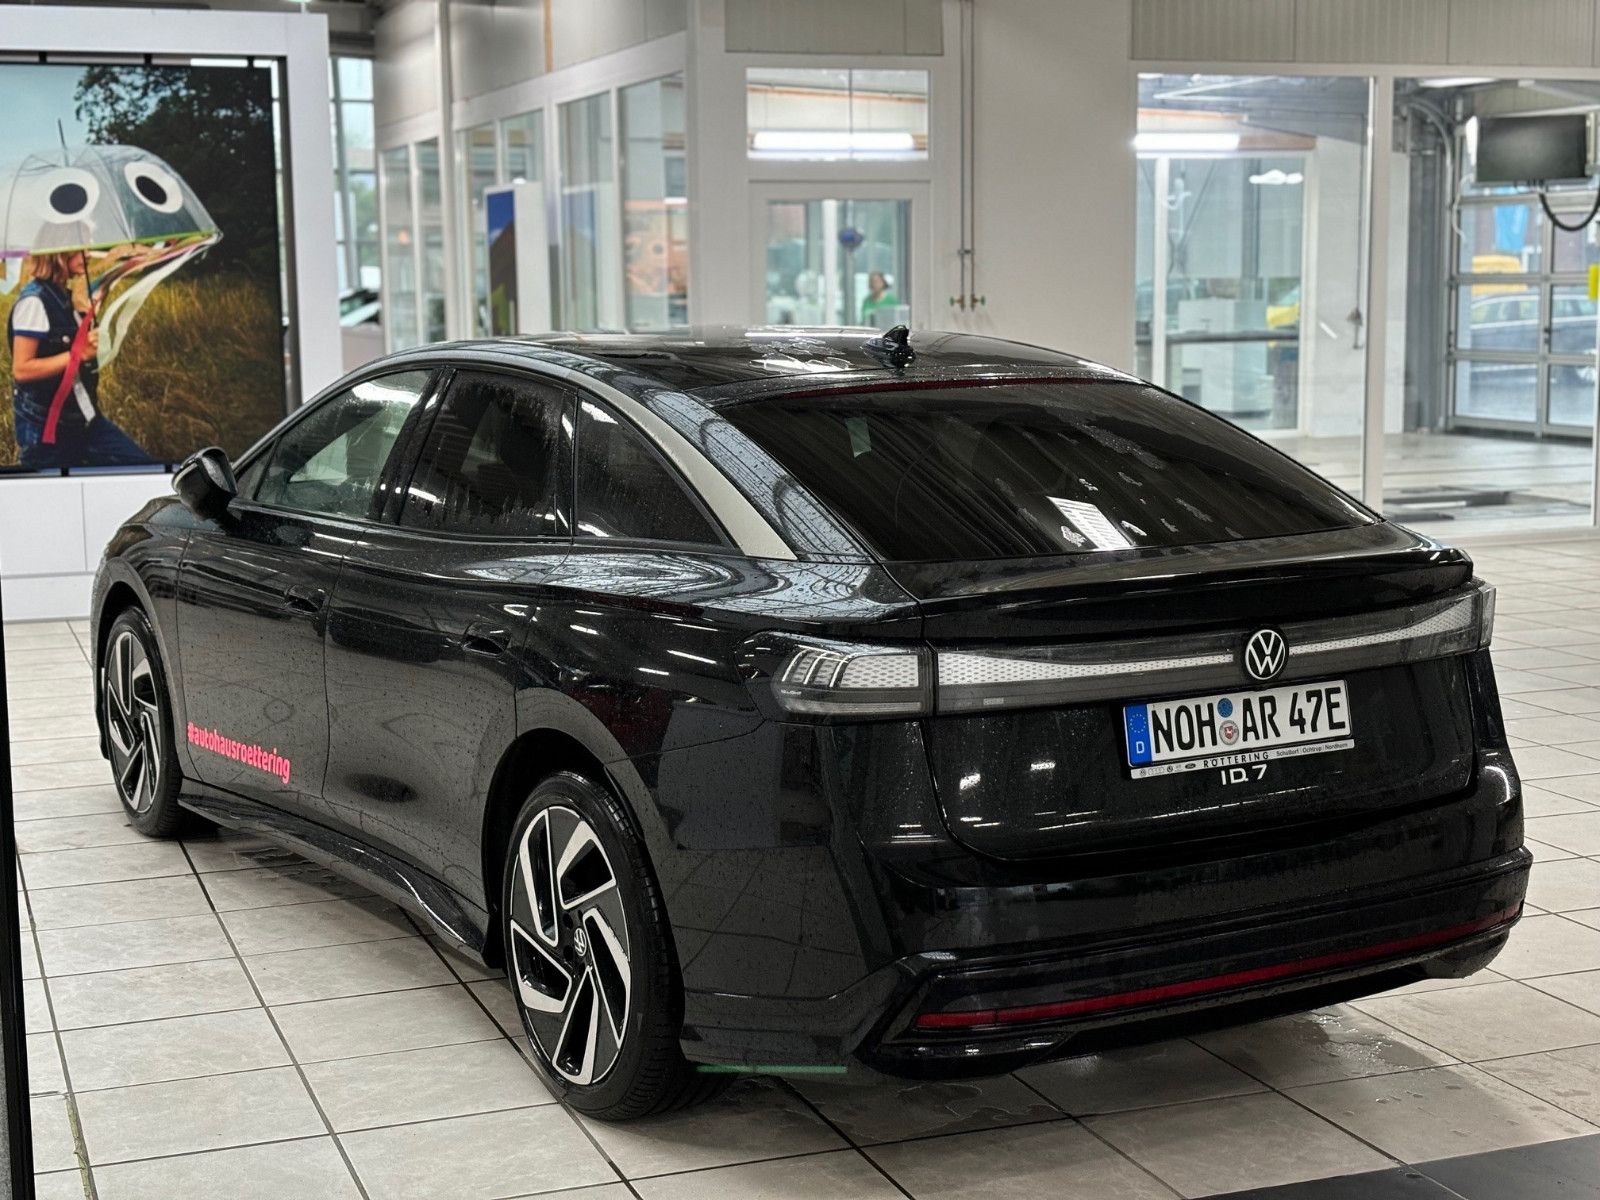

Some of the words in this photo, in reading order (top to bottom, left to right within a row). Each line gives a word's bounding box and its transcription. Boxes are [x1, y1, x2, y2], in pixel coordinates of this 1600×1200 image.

[187, 721, 290, 784] #autohausroettering
[1136, 741, 1145, 754] D
[1151, 703, 1218, 753] NOH
[1242, 695, 1281, 742] AR
[1289, 686, 1346, 734] 47E
